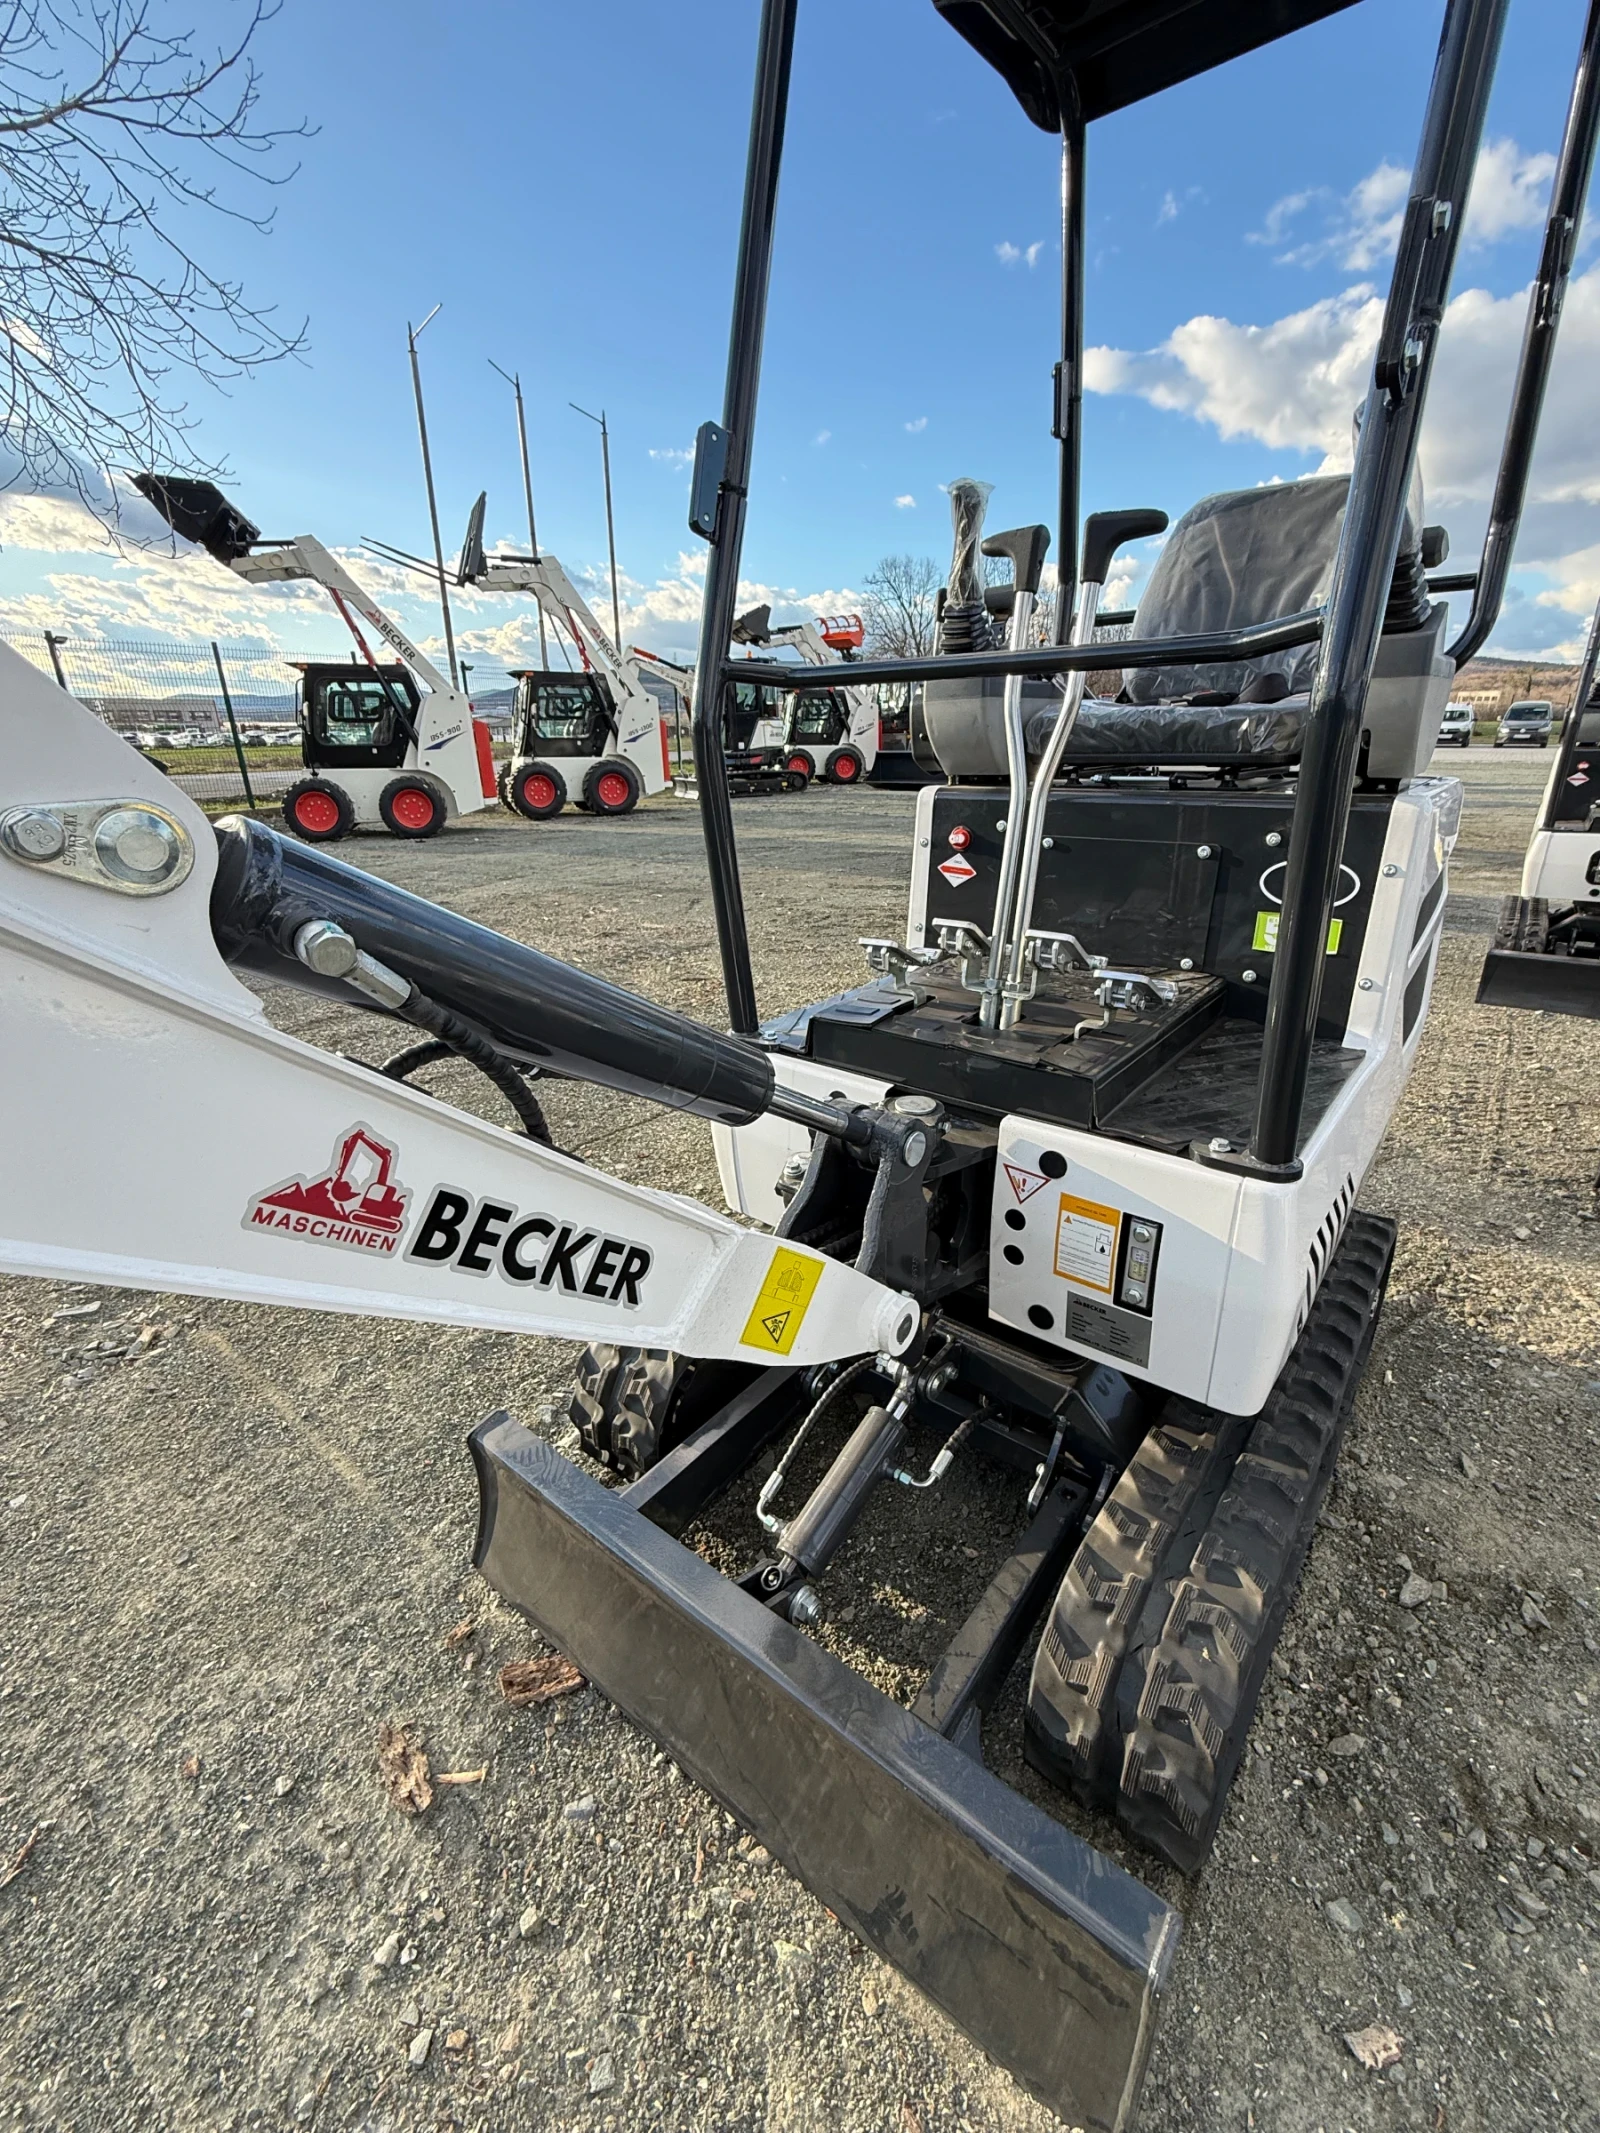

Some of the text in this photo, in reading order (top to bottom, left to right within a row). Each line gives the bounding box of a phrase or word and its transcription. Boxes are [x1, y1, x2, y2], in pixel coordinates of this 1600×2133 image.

[380, 622, 417, 662] BECKER
[599, 638, 623, 670] BECKER
[251, 1206, 397, 1252] MASCHINEN
[410, 1189, 652, 1306] BECKER
[1082, 1302, 1107, 1316] BECKER
